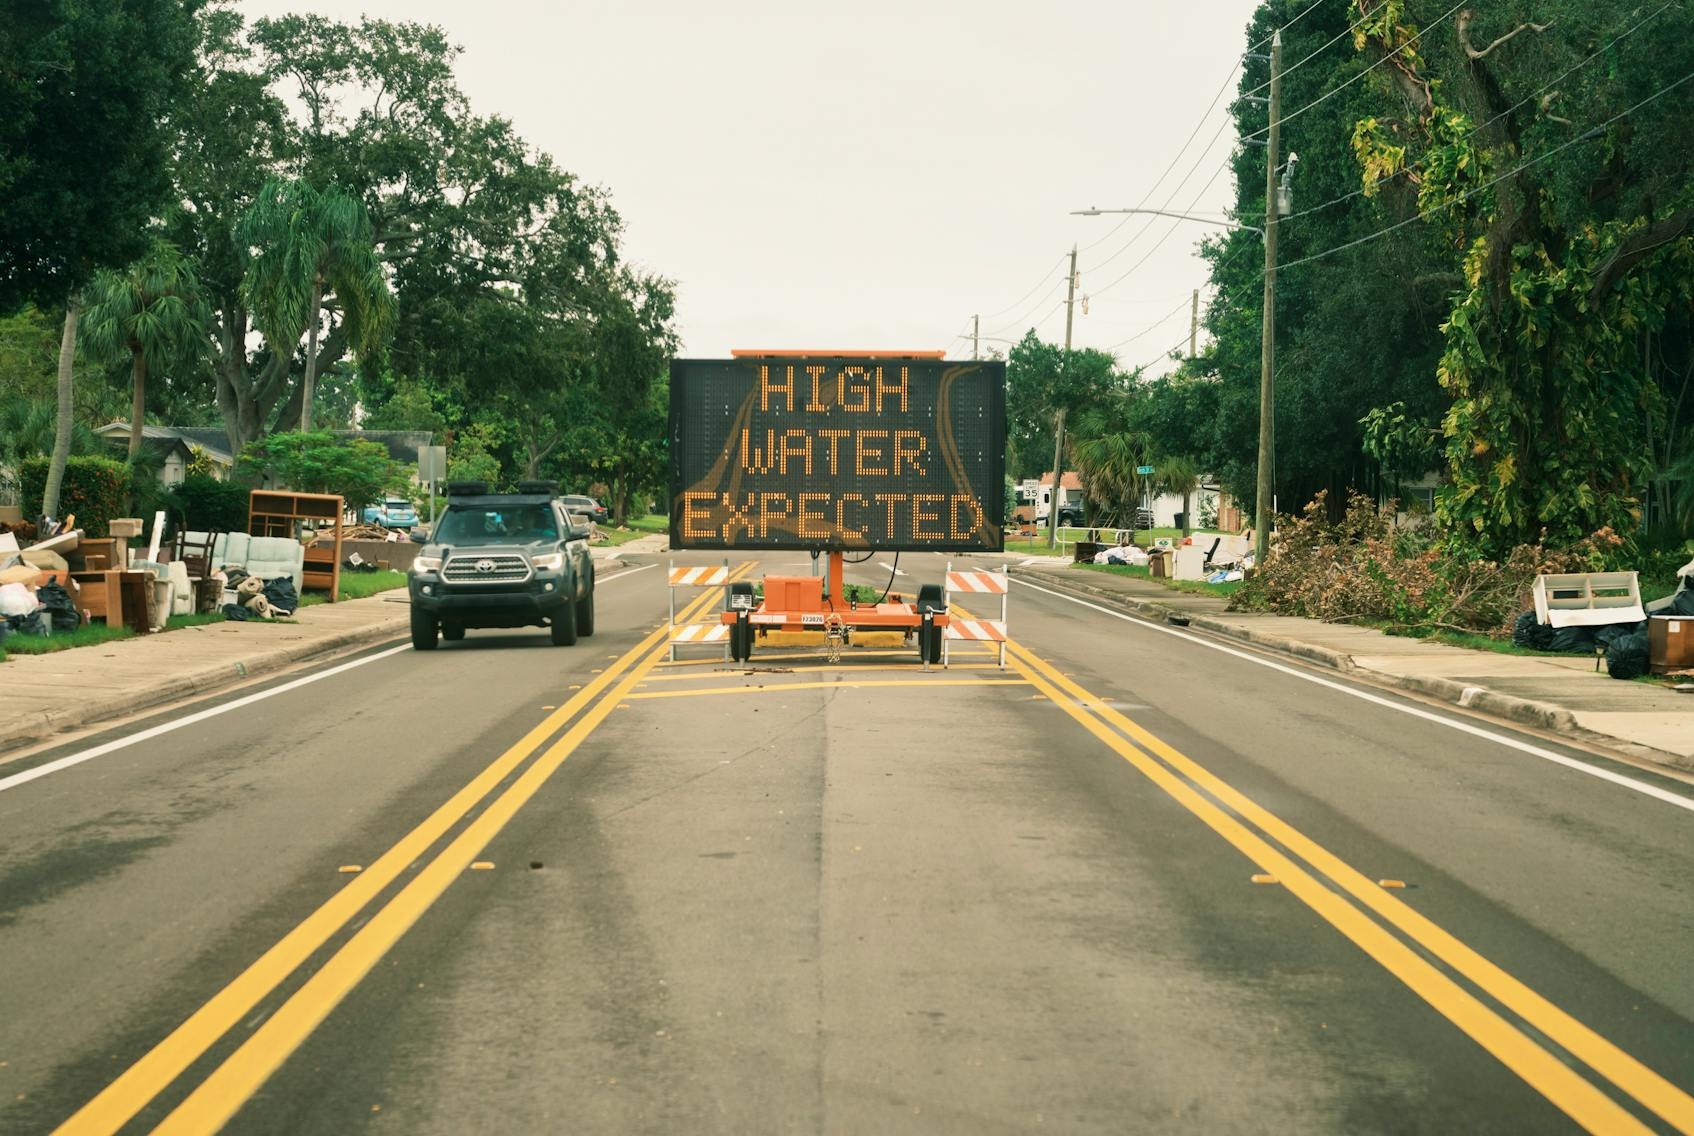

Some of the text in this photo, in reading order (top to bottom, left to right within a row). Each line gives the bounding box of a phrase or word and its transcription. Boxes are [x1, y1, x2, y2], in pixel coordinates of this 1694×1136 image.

[761, 366, 908, 413] HIGH
[742, 429, 927, 476] WATER
[684, 492, 983, 540] EXPECTED
